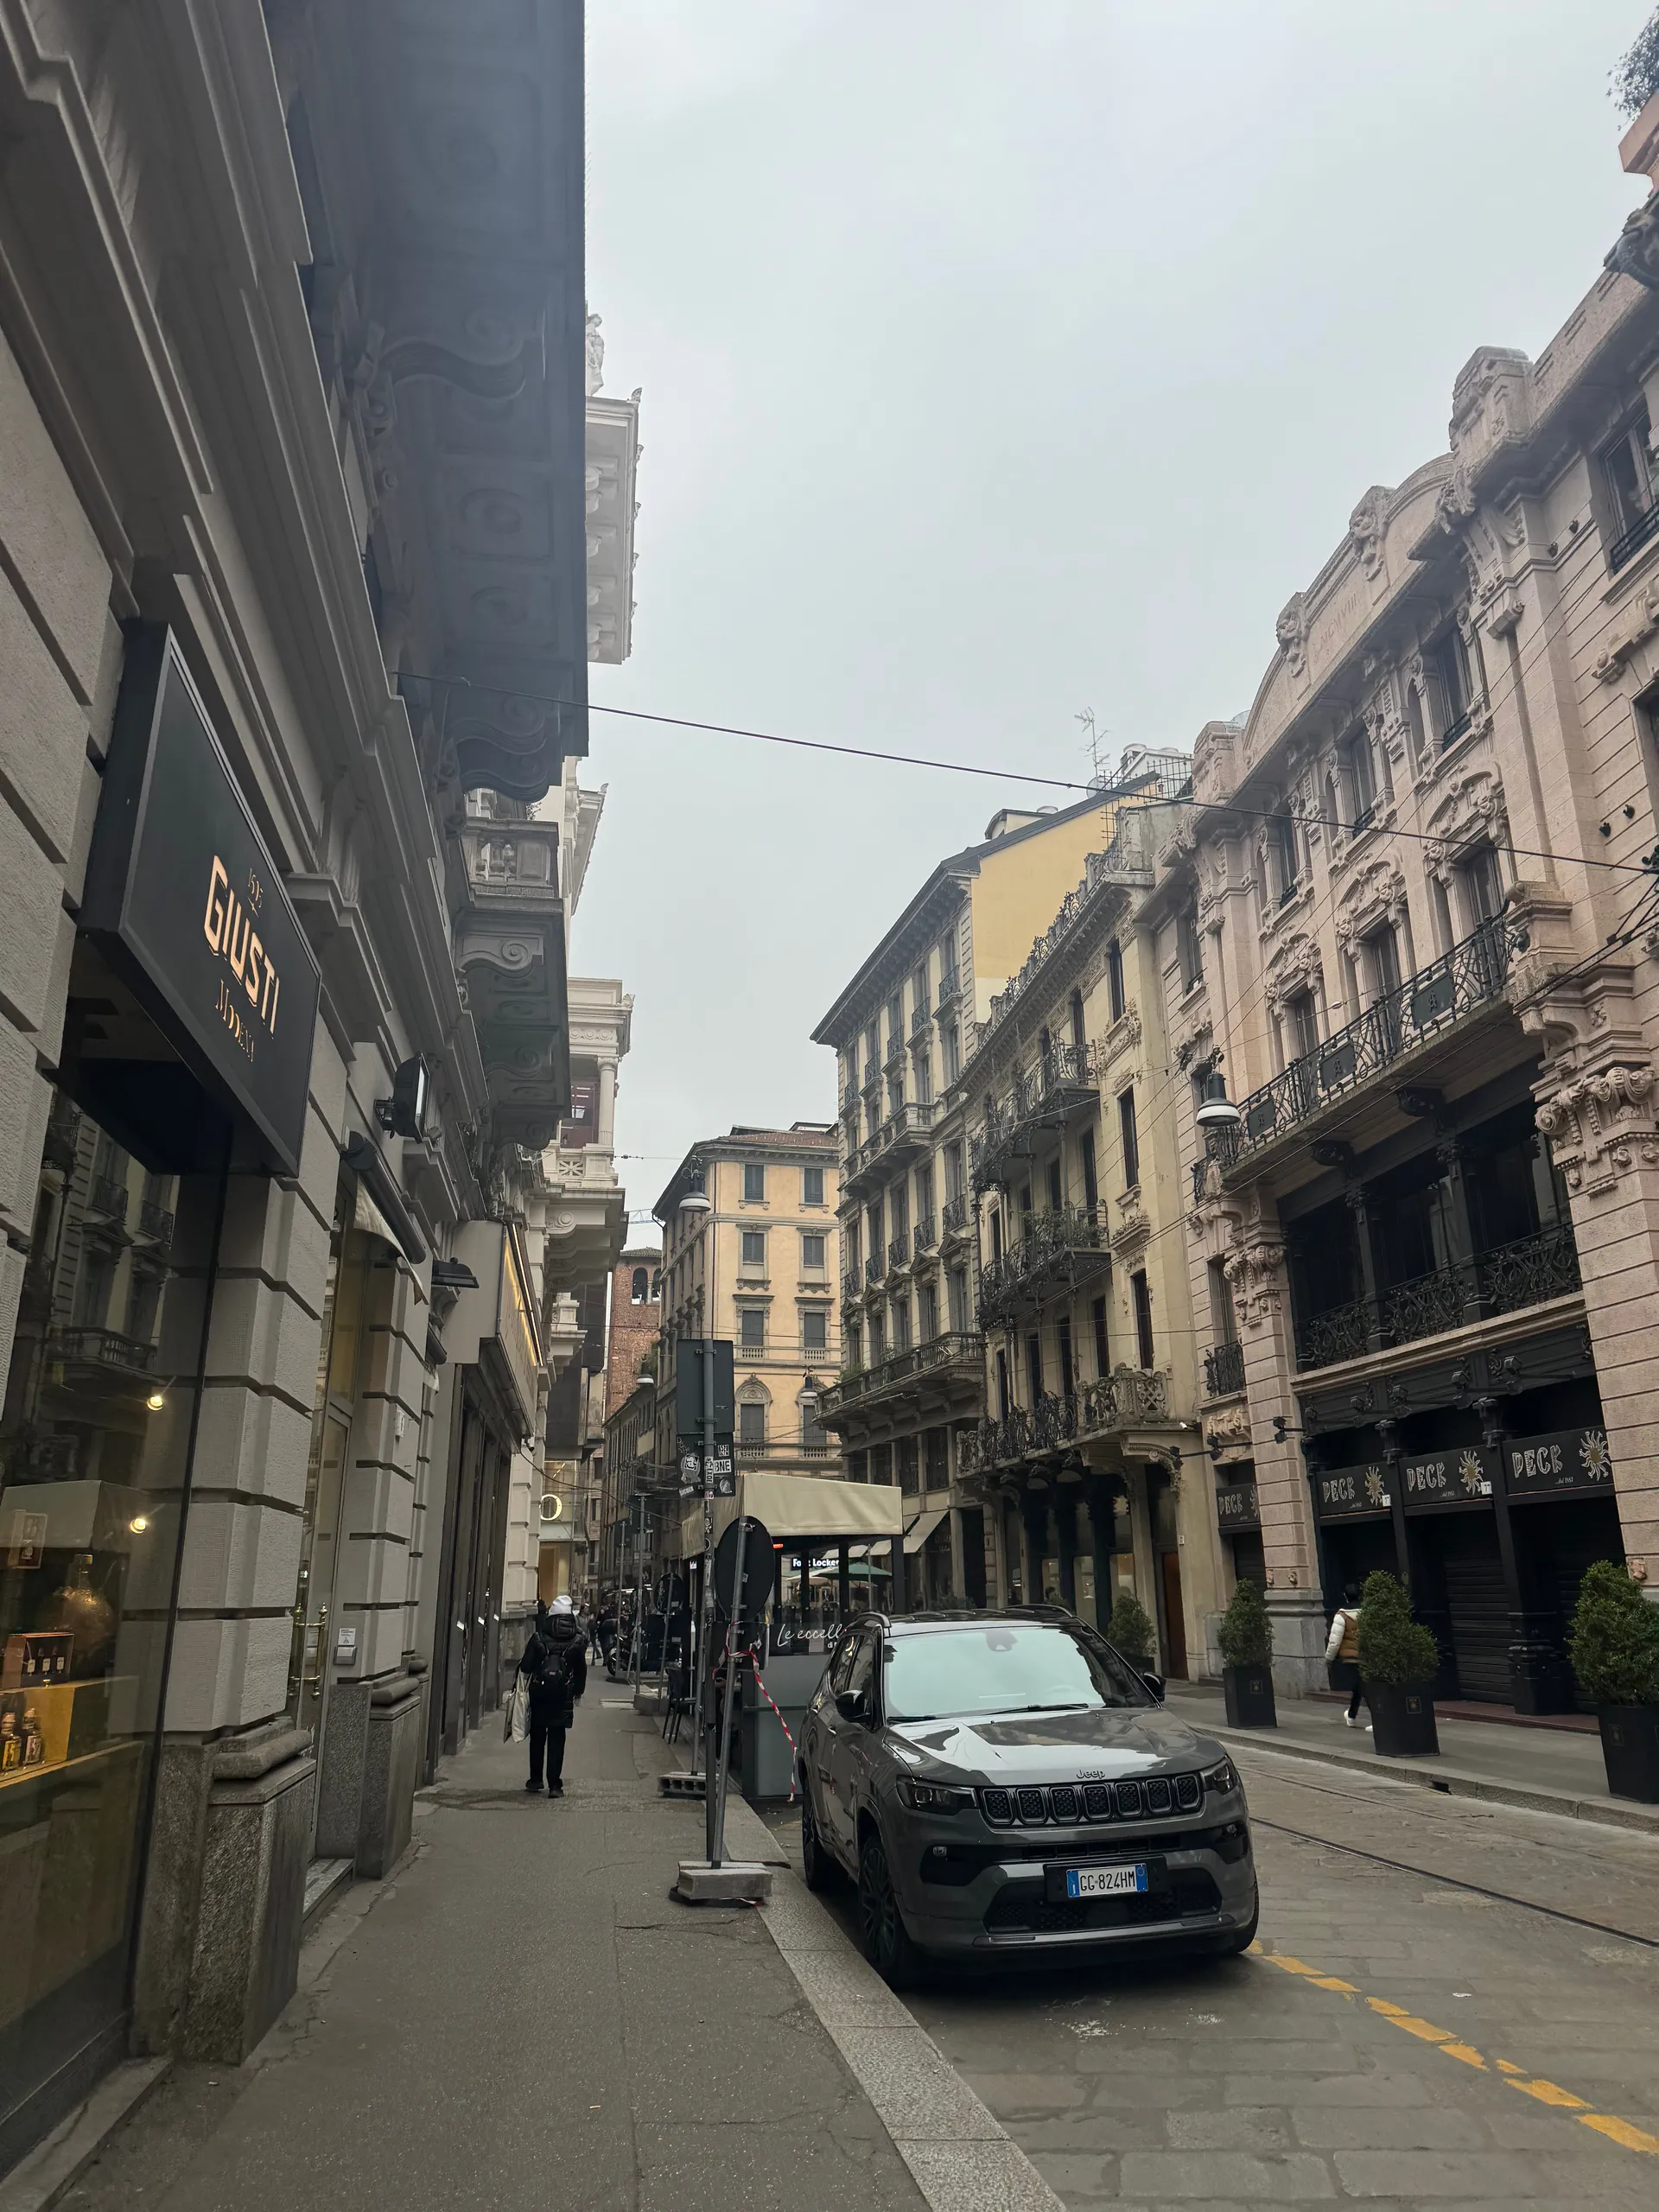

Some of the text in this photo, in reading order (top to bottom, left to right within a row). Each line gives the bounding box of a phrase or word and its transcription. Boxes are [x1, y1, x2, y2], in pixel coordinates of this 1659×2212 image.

[204, 855, 280, 1037] GIUSTI
[714, 1460, 730, 1472] BNE
[1511, 1444, 1563, 1478] PECK
[1406, 1461, 1447, 1492] PECK
[1322, 1476, 1355, 1503] PECK
[1217, 1493, 1243, 1515] PECK
[812, 1558, 840, 1567] Locker
[777, 1624, 795, 1647] Le
[1076, 1769, 1106, 1780] Jeep
